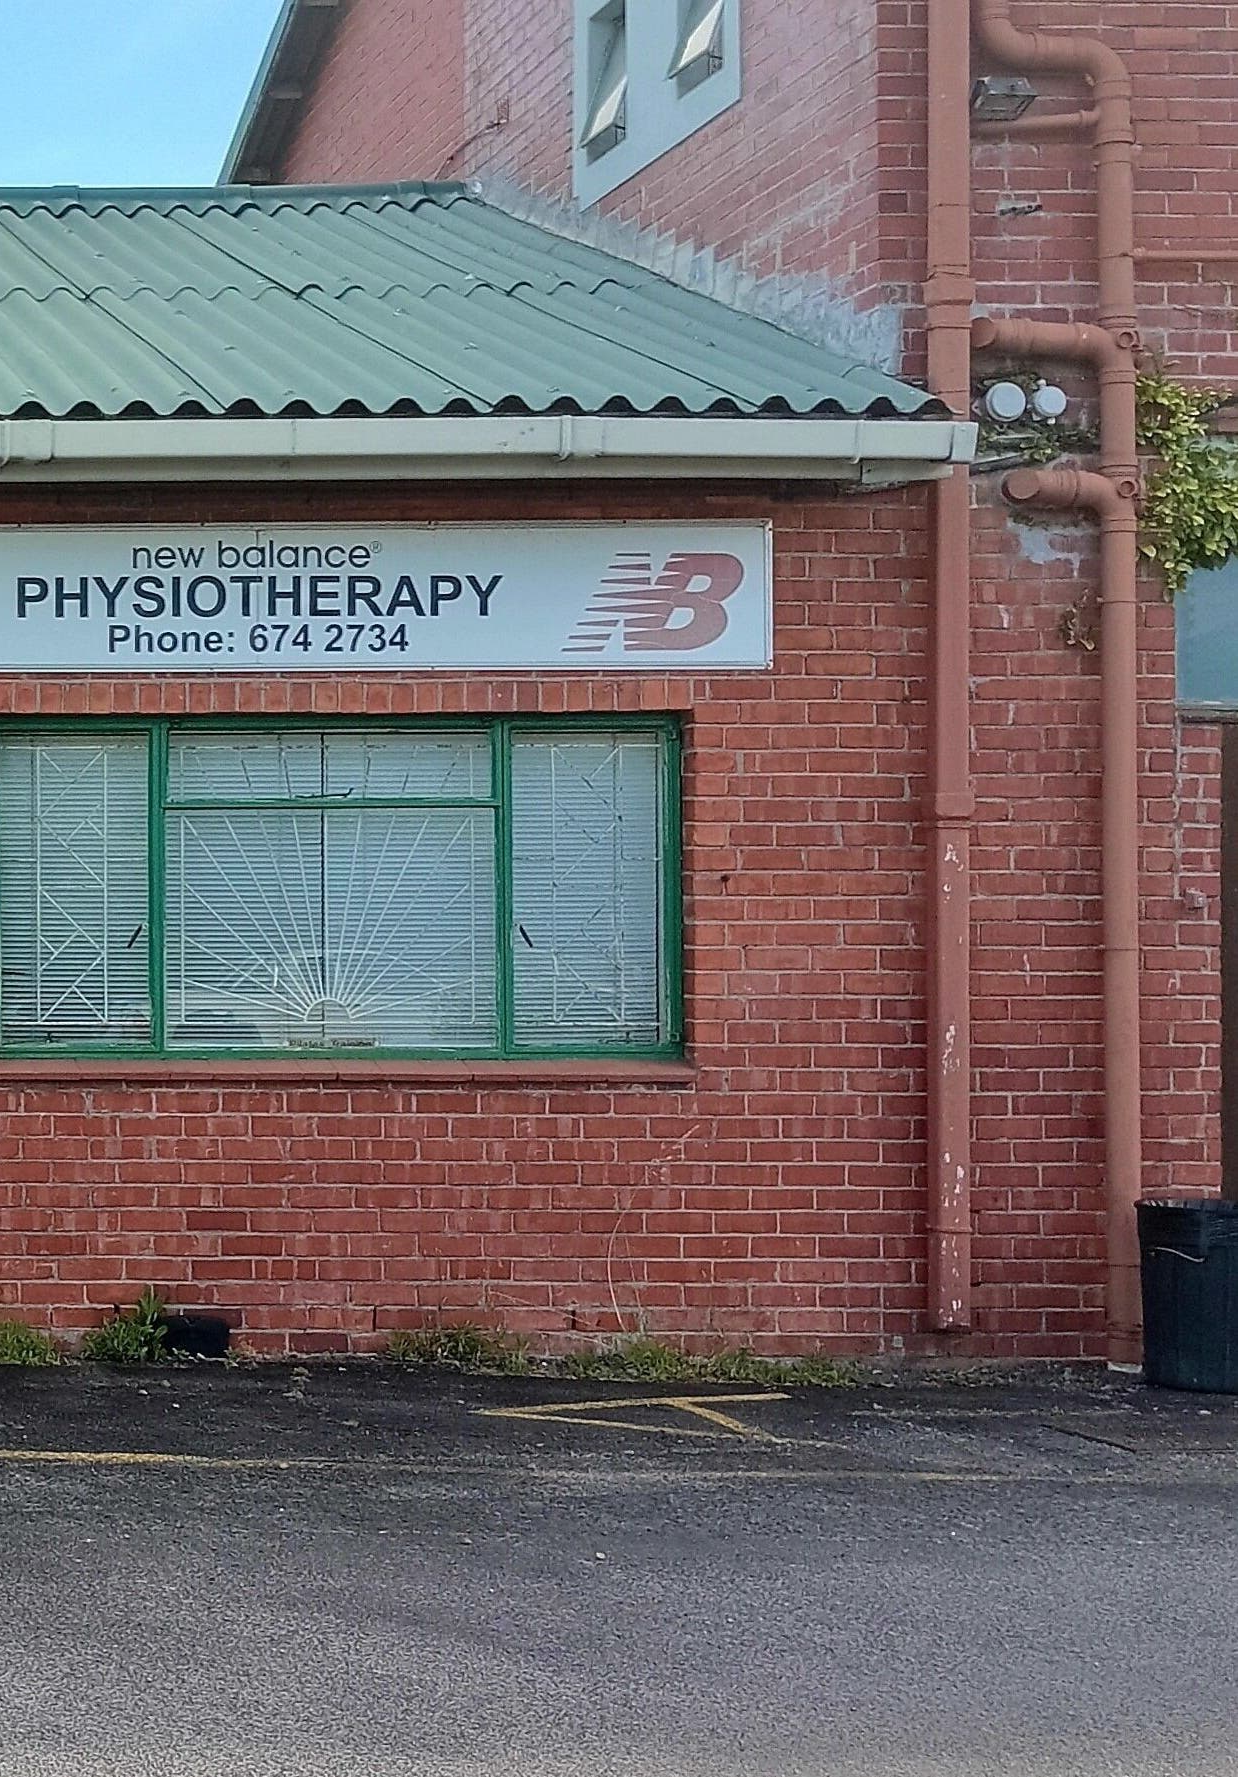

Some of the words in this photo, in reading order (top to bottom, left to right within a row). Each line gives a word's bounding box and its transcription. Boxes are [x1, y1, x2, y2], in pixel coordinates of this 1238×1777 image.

[132, 546, 205, 569] new
[16, 575, 504, 619] PHYSIOTHERAPY
[108, 624, 236, 653] Phone:
[249, 623, 312, 653] 674
[323, 623, 410, 653] 2734
